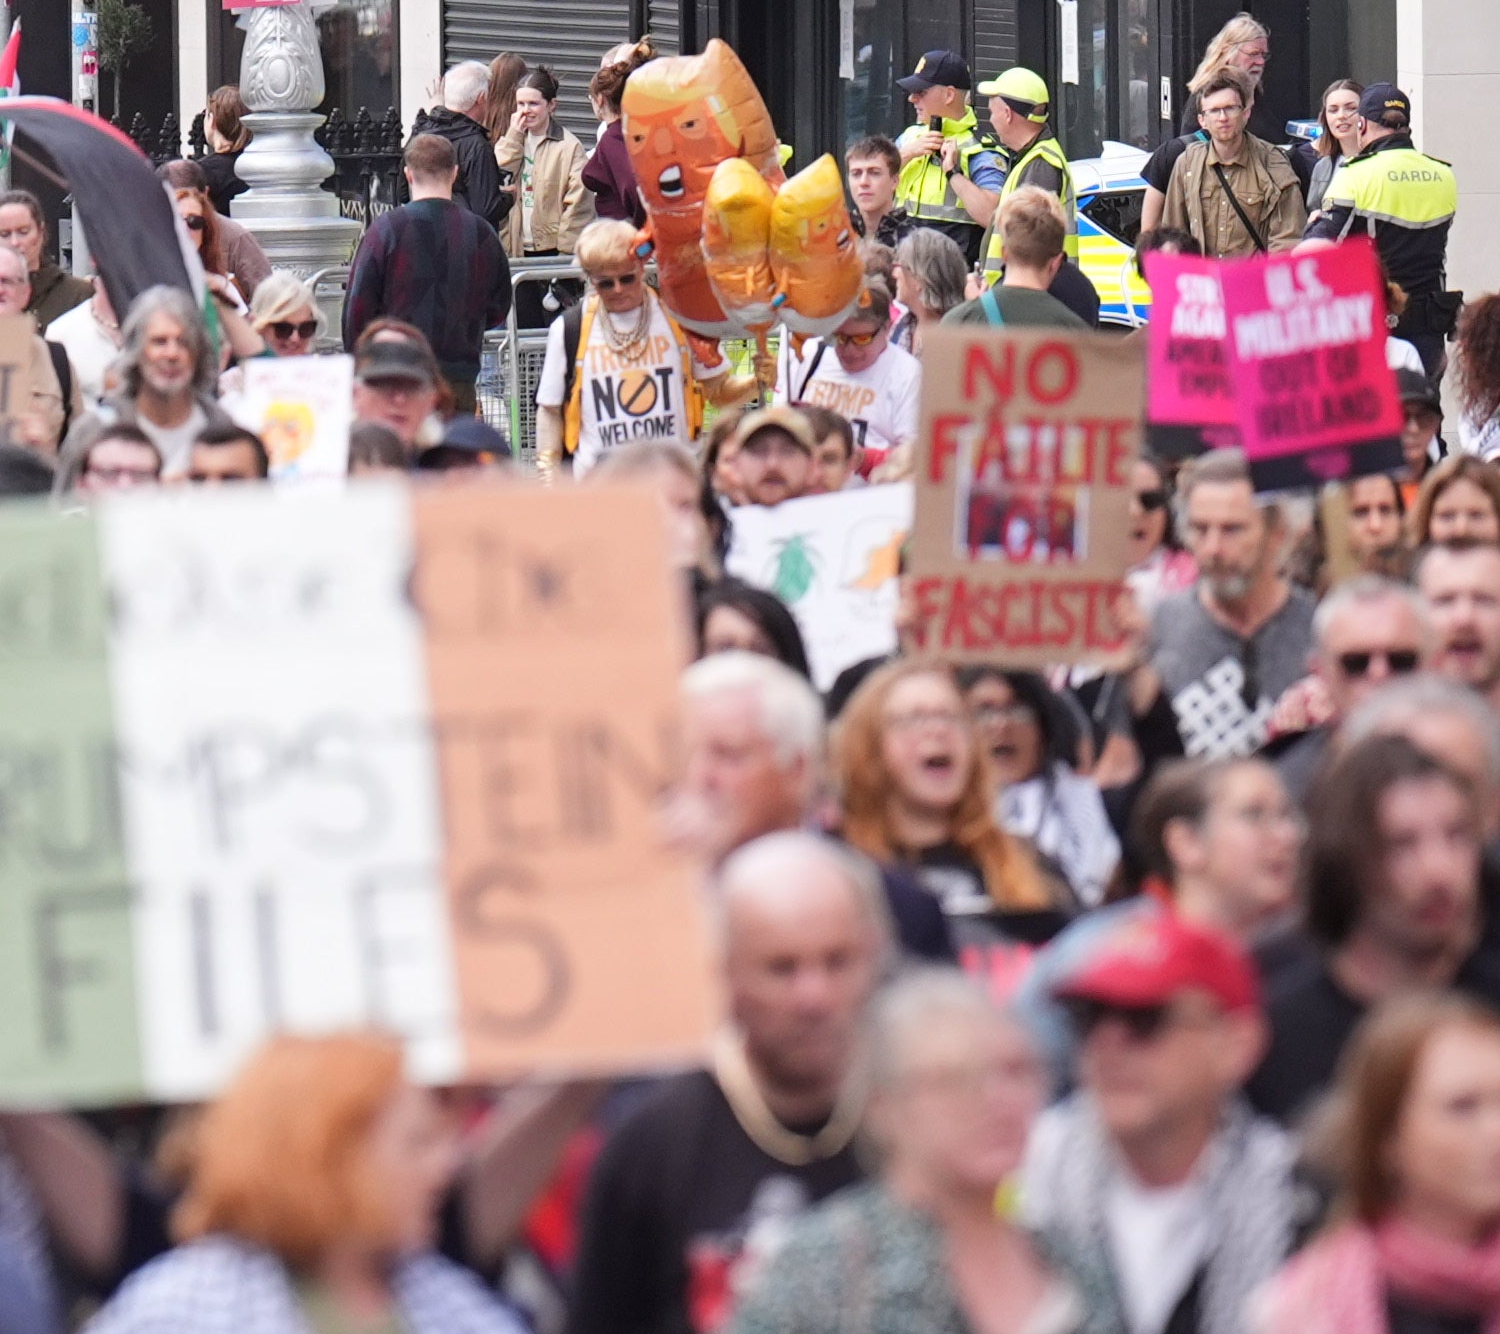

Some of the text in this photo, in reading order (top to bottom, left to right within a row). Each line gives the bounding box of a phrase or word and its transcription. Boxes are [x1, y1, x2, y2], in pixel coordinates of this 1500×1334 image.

[1387, 170, 1442, 182] GARDA
[586, 335, 671, 373] TRUMP
[1234, 294, 1374, 363] MILITARY
[963, 340, 1080, 406] NO
[597, 414, 676, 447] WELCOME
[30, 867, 574, 1055] FILES
